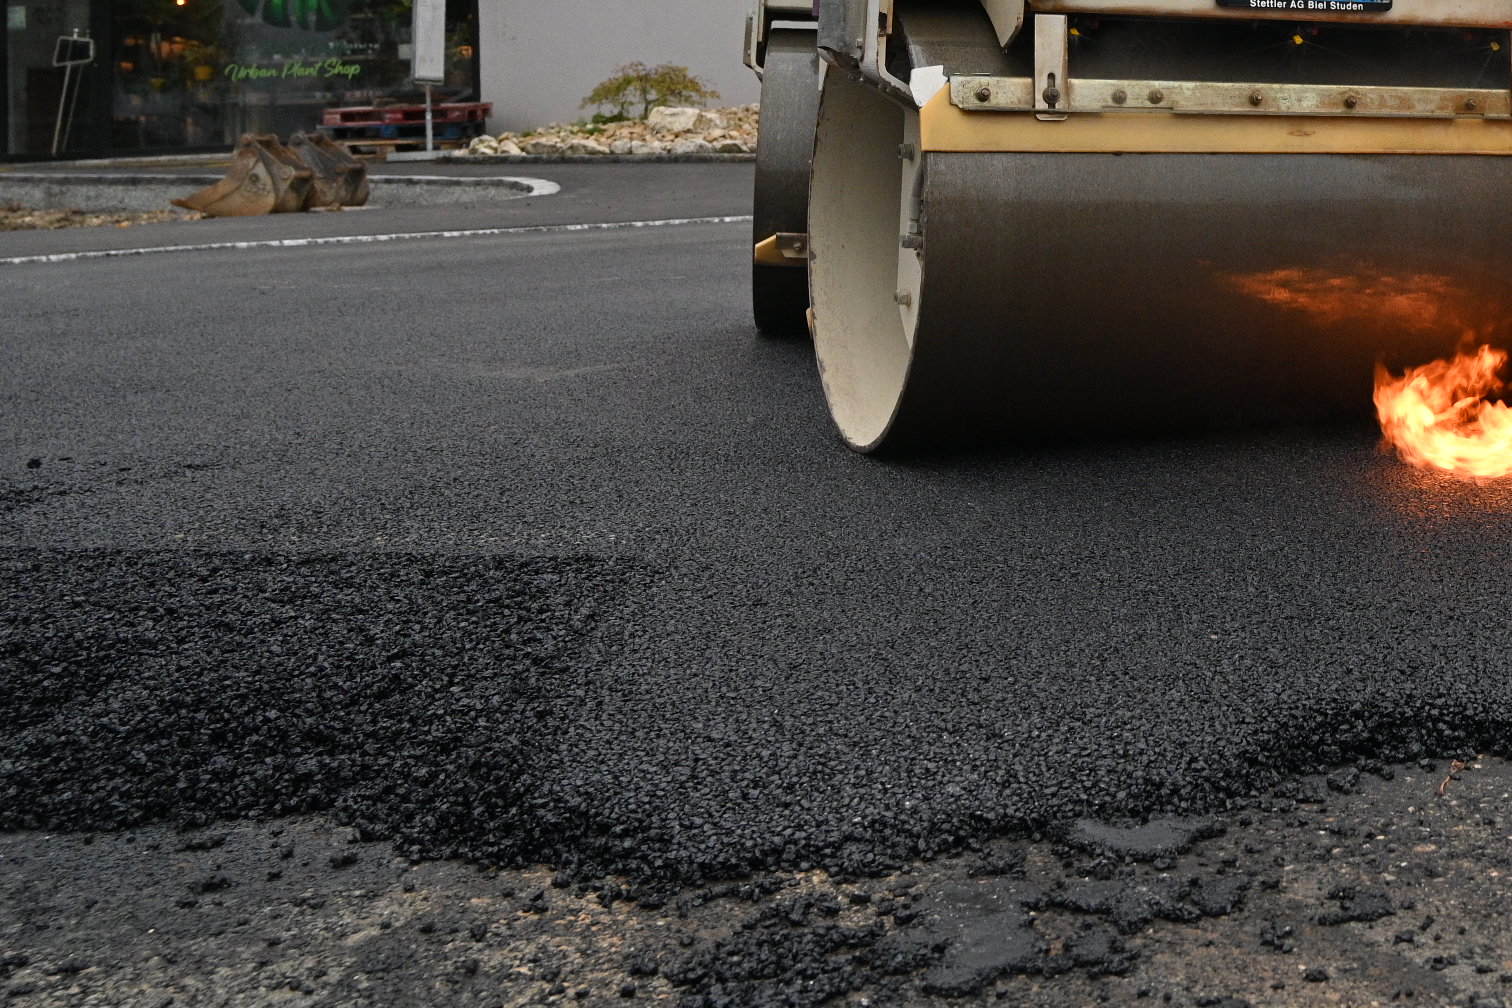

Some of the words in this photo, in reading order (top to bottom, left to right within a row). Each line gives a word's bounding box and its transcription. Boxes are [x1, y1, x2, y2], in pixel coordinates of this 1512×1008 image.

[1290, 0, 1305, 9] AG
[1308, 0, 1327, 10] Biel
[1330, 1, 1364, 11] Studen
[225, 63, 277, 81] Urban
[281, 60, 323, 79] Plant
[323, 57, 362, 80] Shop
